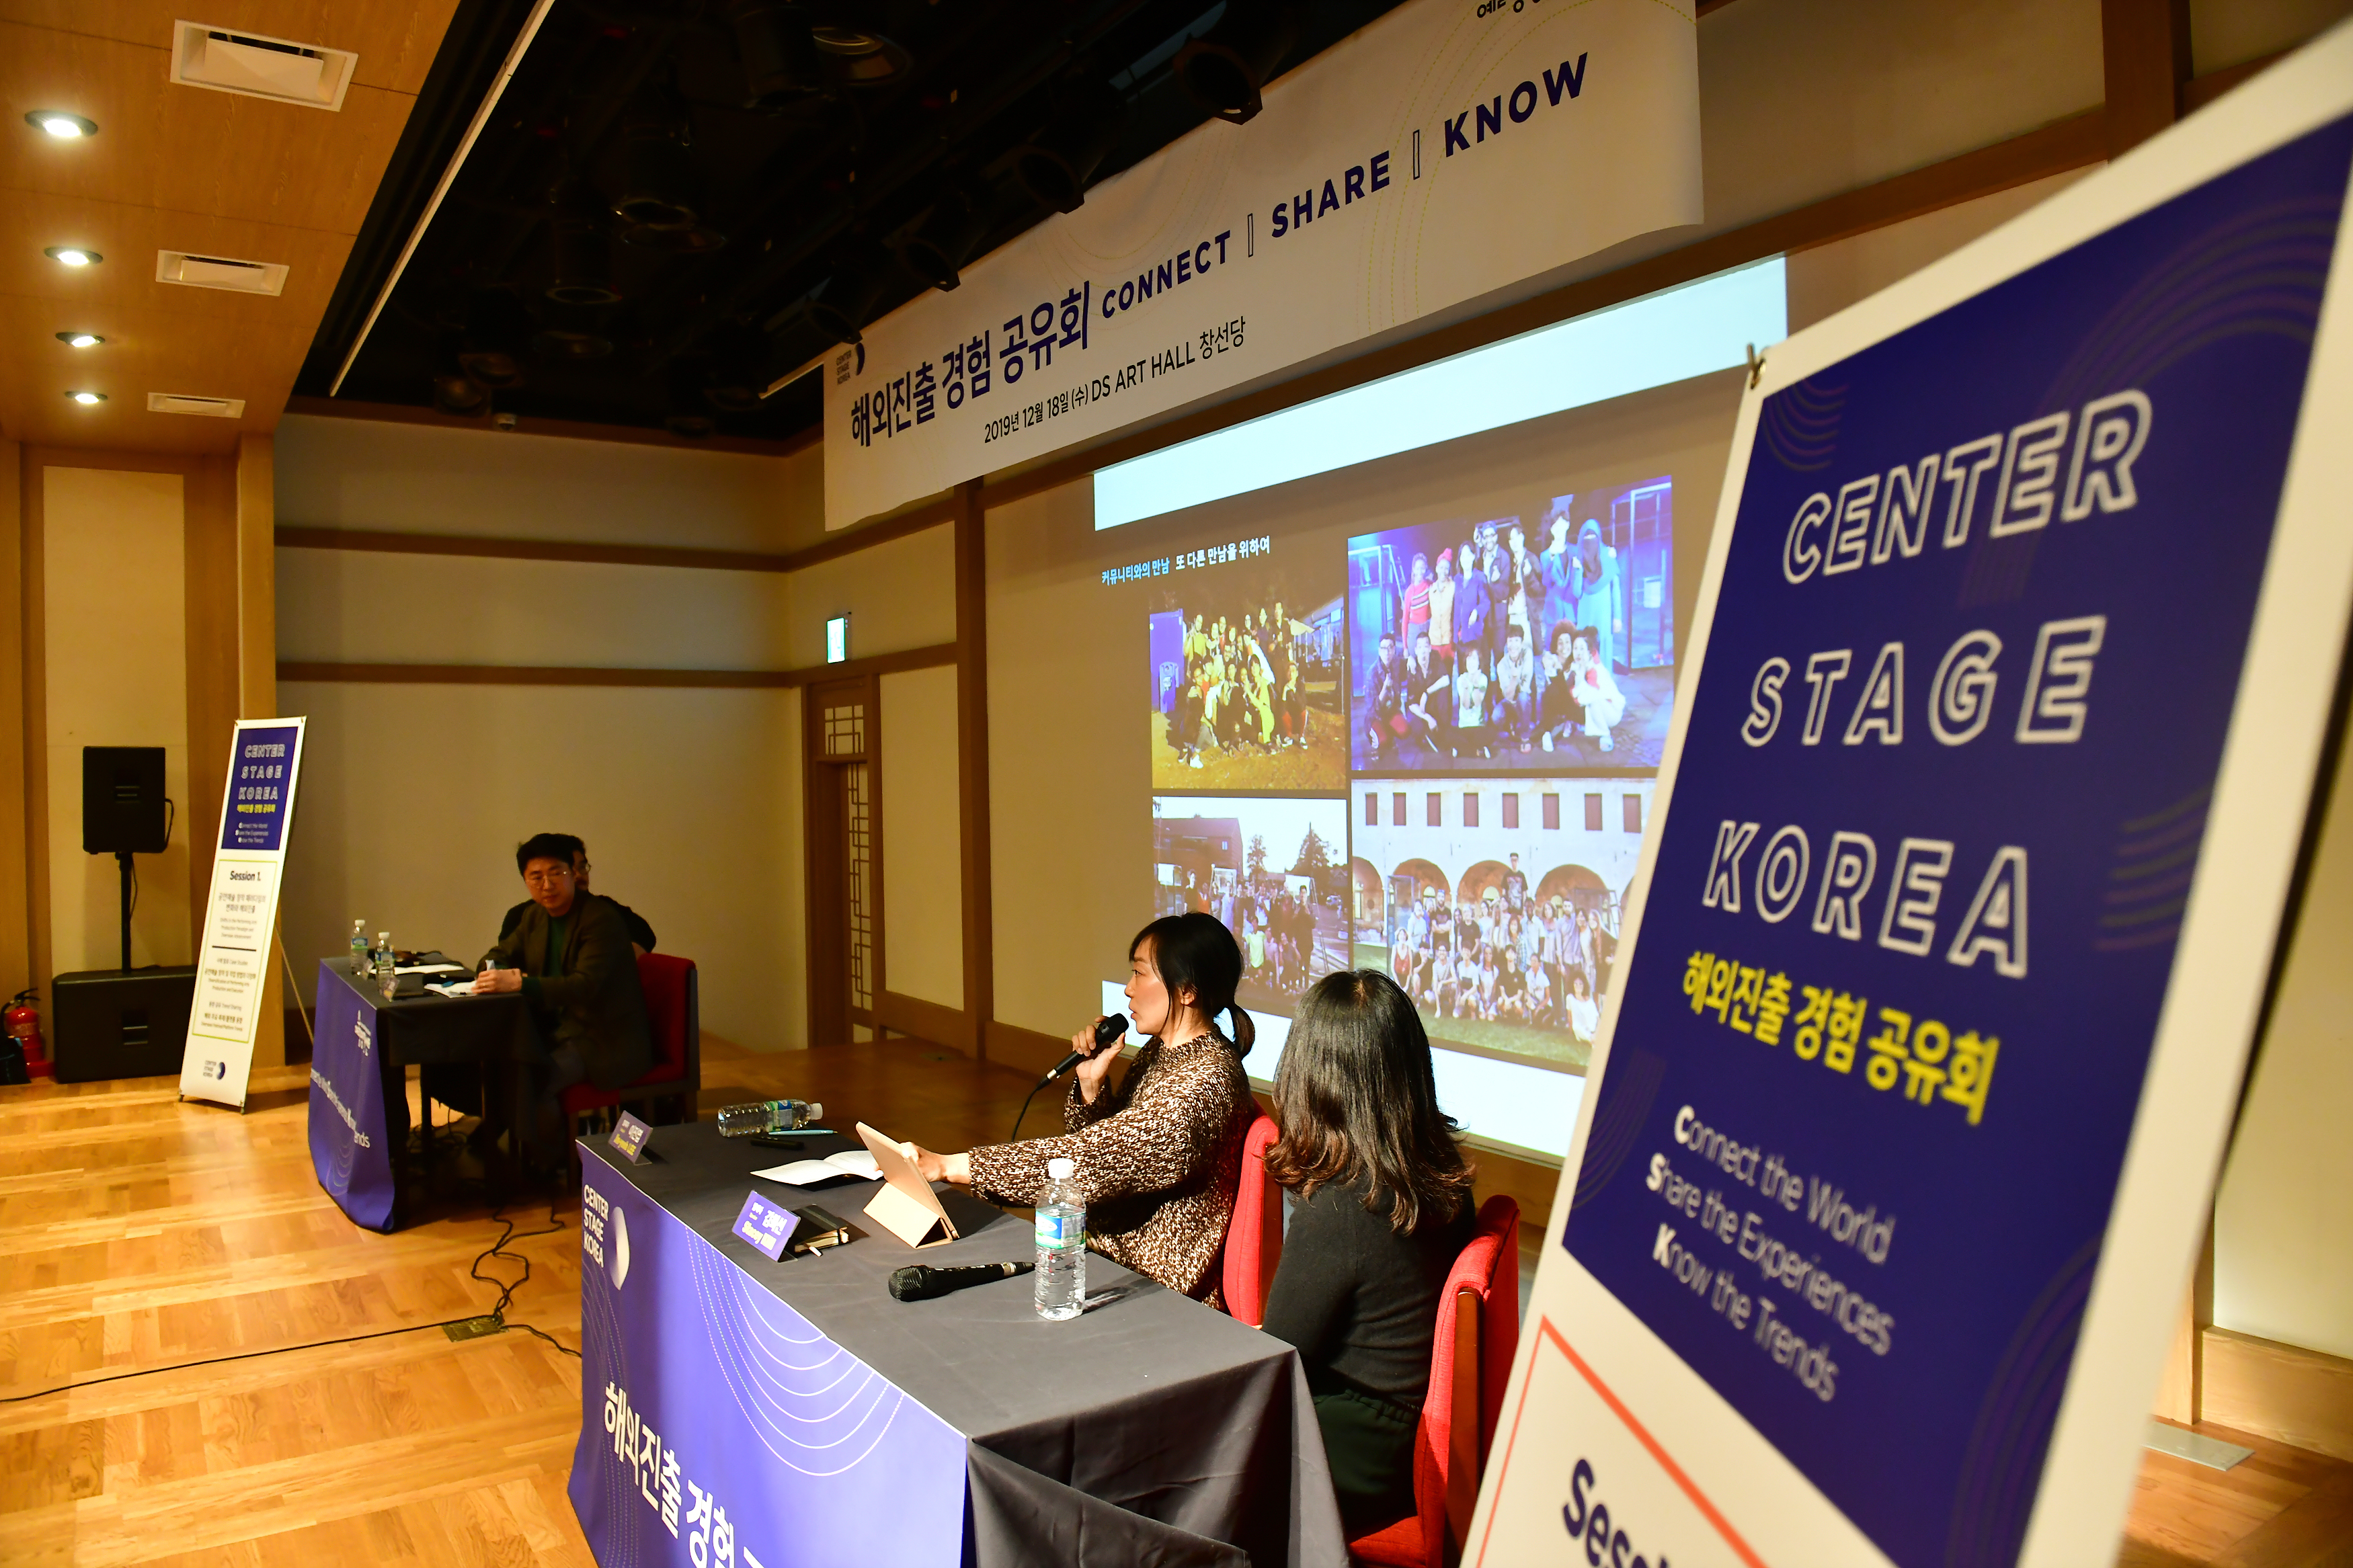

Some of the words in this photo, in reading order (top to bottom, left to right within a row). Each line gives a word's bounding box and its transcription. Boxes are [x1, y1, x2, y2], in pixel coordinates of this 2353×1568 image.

[1102, 230, 1230, 319] CONNECT
[1272, 151, 1390, 239] SHARE
[1444, 51, 1588, 158] KNOW
[851, 361, 936, 447] 해외진출
[943, 329, 991, 409] 경험
[1000, 280, 1090, 384] 공유회
[984, 411, 1019, 444] 2019년
[1023, 401, 1043, 428] 12월
[1092, 374, 1111, 402] DS
[1115, 359, 1146, 393] ART
[1152, 341, 1196, 378] HALL
[1199, 316, 1246, 360] 창선당
[1782, 388, 2153, 584] CENTER
[1102, 560, 1150, 586] 커뮤니티와의
[1152, 556, 1170, 576] 만남
[1175, 554, 1185, 570] 또
[1187, 549, 1205, 569] 다른
[1207, 542, 1237, 565] 만남을
[1239, 535, 1270, 559] 위하여
[1741, 614, 2108, 747] STAGE
[238, 786, 278, 800] KOREA
[241, 765, 282, 779] STAGE
[245, 743, 285, 758] CENTER
[230, 870, 255, 880] Session
[1702, 819, 2028, 979] KOREA
[1682, 950, 1792, 1046] 해외진출
[1793, 984, 1868, 1075] 경험
[1865, 1006, 2001, 1126] 공유회
[584, 1184, 609, 1222] CENTER
[584, 1208, 604, 1242] STAGE
[1673, 1104, 1761, 1188] Connect
[1759, 1153, 1804, 1212] the
[1807, 1174, 1897, 1264] World
[584, 1231, 604, 1268] KOREA
[1646, 1152, 1702, 1219] Share
[1700, 1189, 1739, 1245] the
[1737, 1211, 1895, 1356] Experiences
[1652, 1222, 1714, 1297] Know
[1711, 1270, 1751, 1330] the
[1754, 1295, 1839, 1402] Trends
[604, 1381, 682, 1540] 해외진출
[686, 1479, 735, 1568] 경험
[1562, 1458, 1669, 1568] Ses
